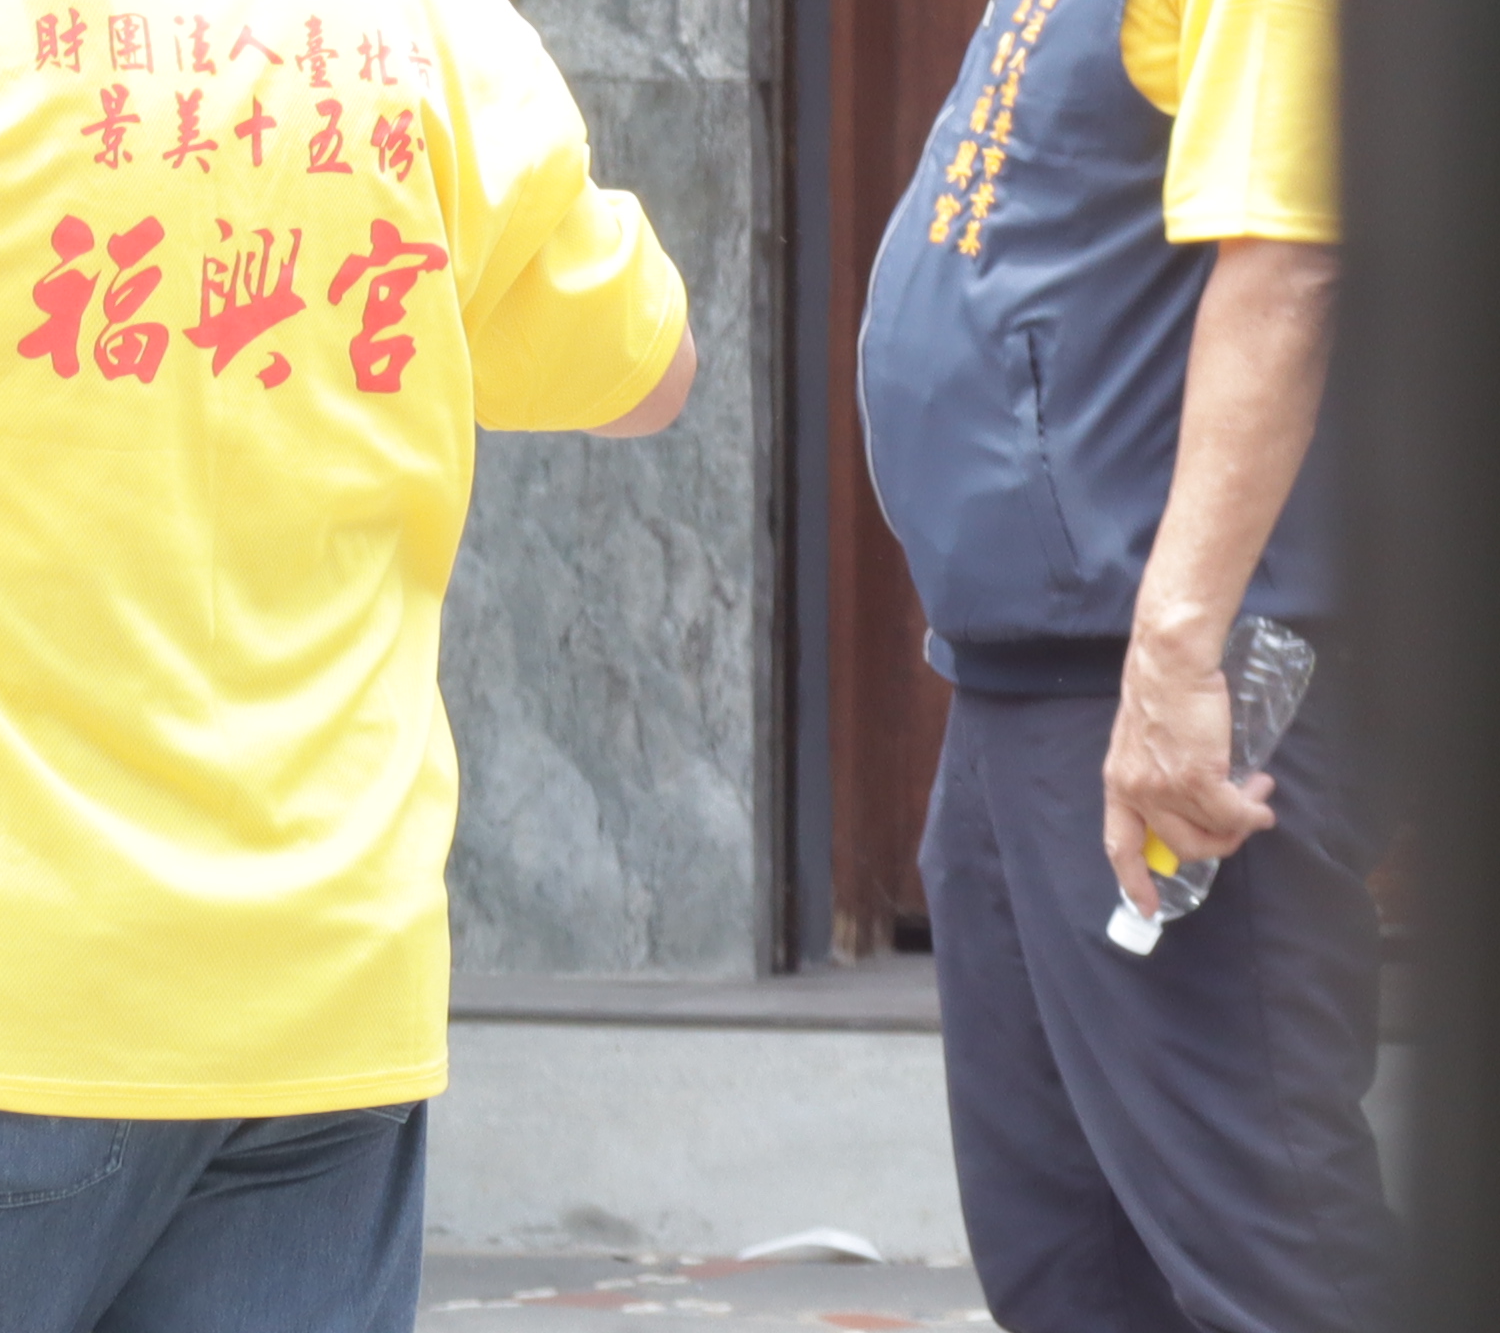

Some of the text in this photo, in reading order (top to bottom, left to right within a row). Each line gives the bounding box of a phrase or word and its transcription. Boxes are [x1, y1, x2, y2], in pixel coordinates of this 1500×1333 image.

[80, 83, 425, 183] 景美十五份
[16, 214, 448, 393] 福興宮
